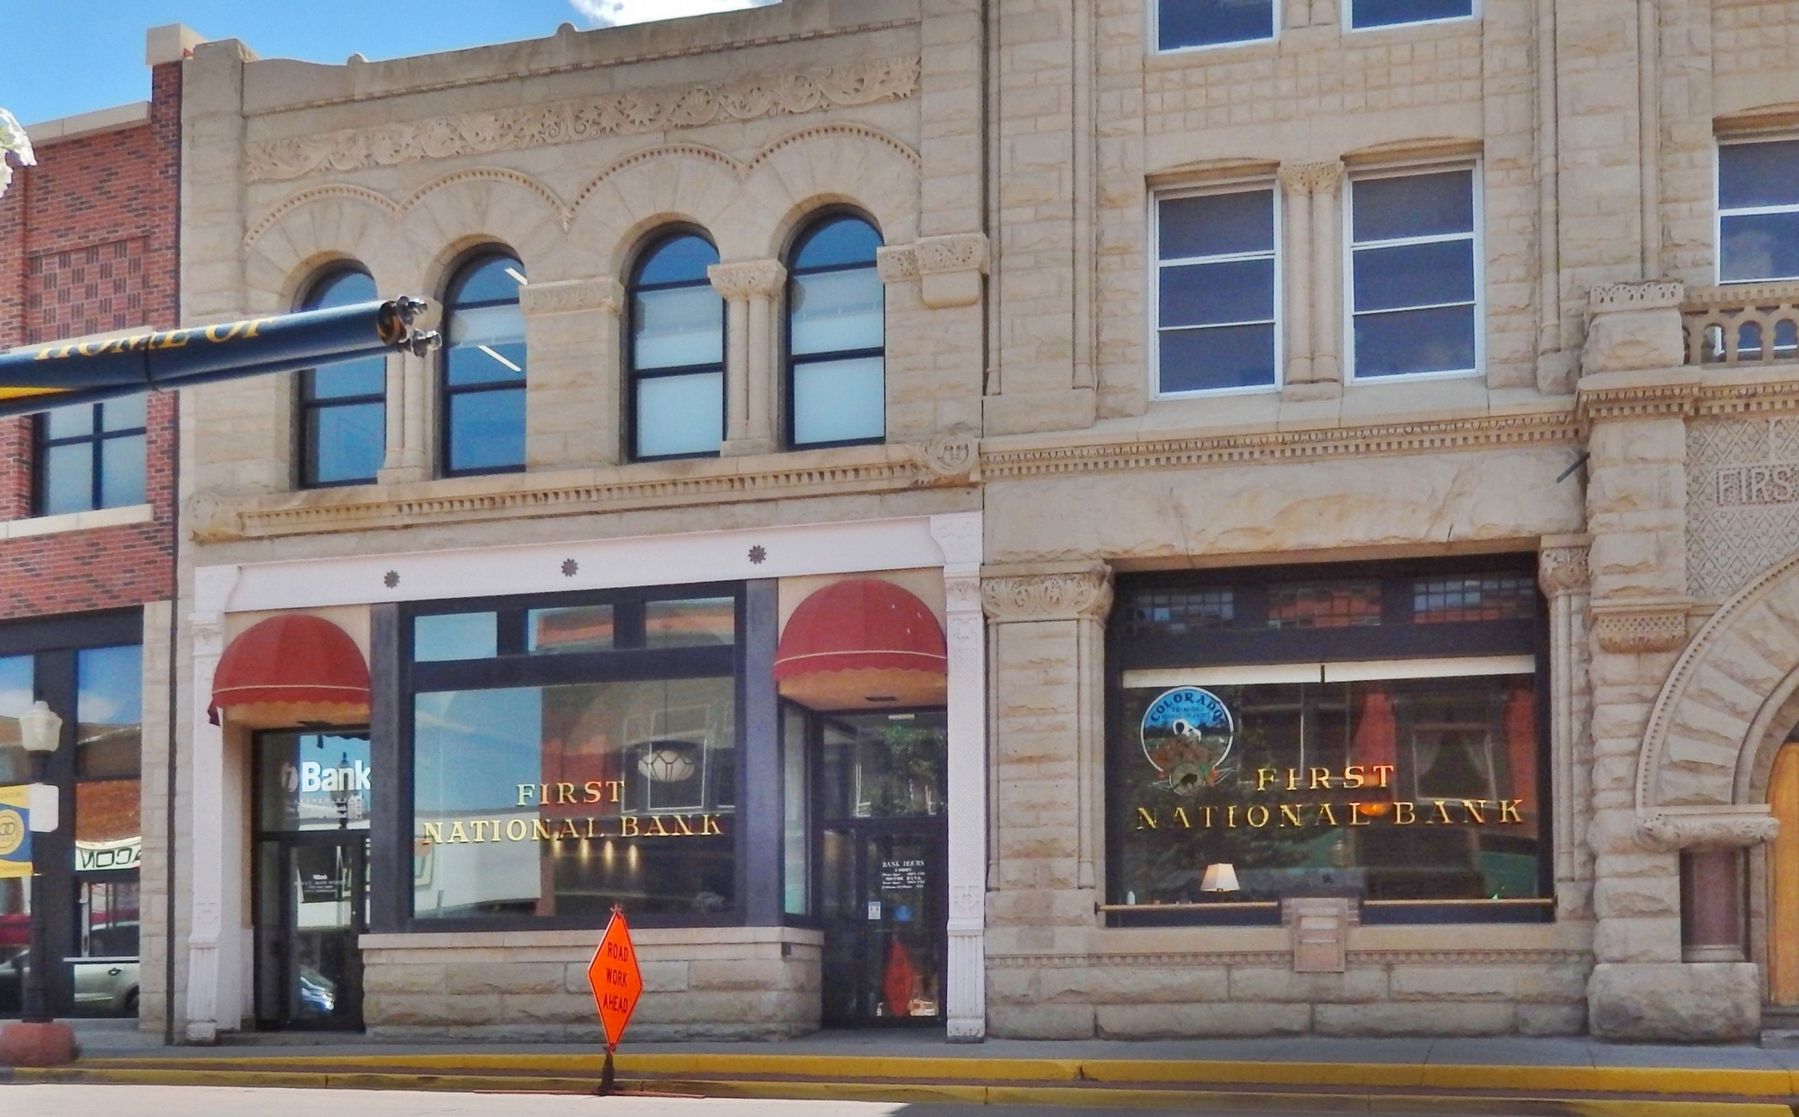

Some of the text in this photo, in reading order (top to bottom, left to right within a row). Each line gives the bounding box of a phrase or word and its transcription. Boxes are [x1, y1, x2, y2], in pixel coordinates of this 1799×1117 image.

[1150, 692, 1224, 722] COLORADO
[1256, 764, 1394, 792] FIRST
[516, 780, 625, 806] FIRST
[1136, 798, 1525, 831] NATIONAL BANK
[422, 813, 726, 845] NATIONAL BANK
[607, 942, 629, 962] ROAD
[606, 967, 628, 988] WORK
[602, 993, 629, 1014] AHEAD
